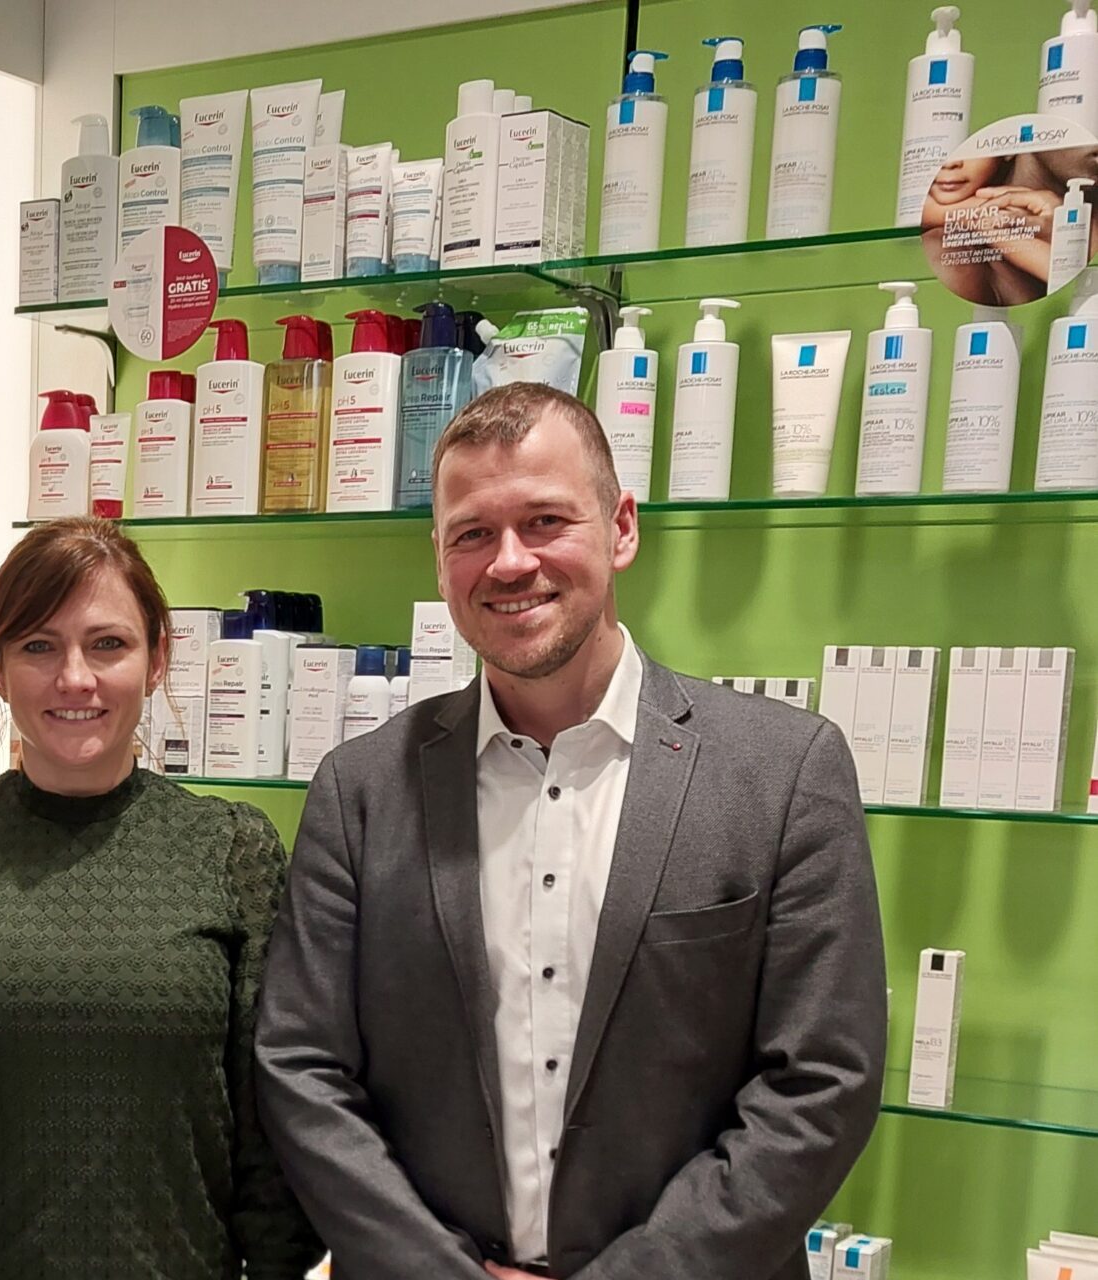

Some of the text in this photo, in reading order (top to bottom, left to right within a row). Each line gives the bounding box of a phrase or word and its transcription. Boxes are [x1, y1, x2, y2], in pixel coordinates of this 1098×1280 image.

[267, 103, 299, 115] Eucerin
[195, 110, 225, 123] Eucerin
[509, 126, 538, 138] Eucerin
[454, 135, 477, 148] Eucerin
[976, 138, 990, 149] LA
[356, 153, 378, 164] Eucerin
[131, 162, 161, 175] Eucerin
[70, 173, 98, 185] Eucerin
[944, 206, 999, 222] LIPIKAR
[944, 218, 989, 234] BAUME
[179, 249, 201, 259] Eucerin
[503, 340, 546, 353] Eucerin
[343, 368, 375, 380] Eucerin
[411, 365, 445, 377] Eucerin
[208, 379, 239, 391] Eucerin
[277, 374, 308, 386] Eucerin
[337, 395, 356, 407] pH5
[145, 410, 169, 420] Eucerin
[203, 404, 221, 415] pH5
[894, 418, 915, 431] 10%
[979, 415, 1000, 427] 10%
[420, 622, 446, 632] Eucerin
[304, 659, 328, 669] Eucerin
